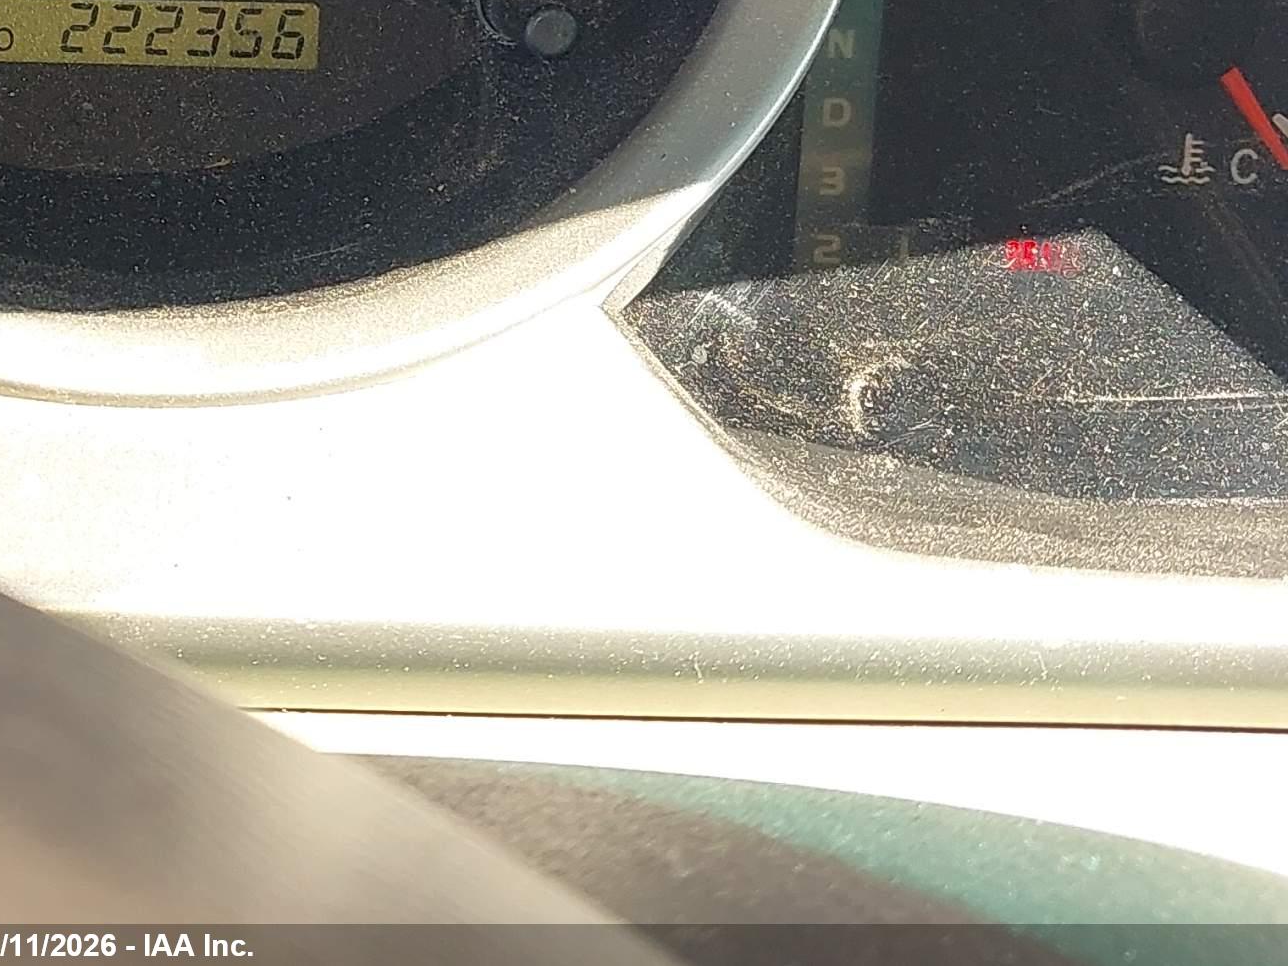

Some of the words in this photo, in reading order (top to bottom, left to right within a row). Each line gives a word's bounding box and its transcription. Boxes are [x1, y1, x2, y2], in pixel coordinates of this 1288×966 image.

[60, 1, 307, 61] 222356
[827, 30, 855, 59] N
[823, 97, 851, 127] D
[819, 166, 846, 196] 3
[1230, 148, 1259, 185] C
[813, 233, 842, 263] 2
